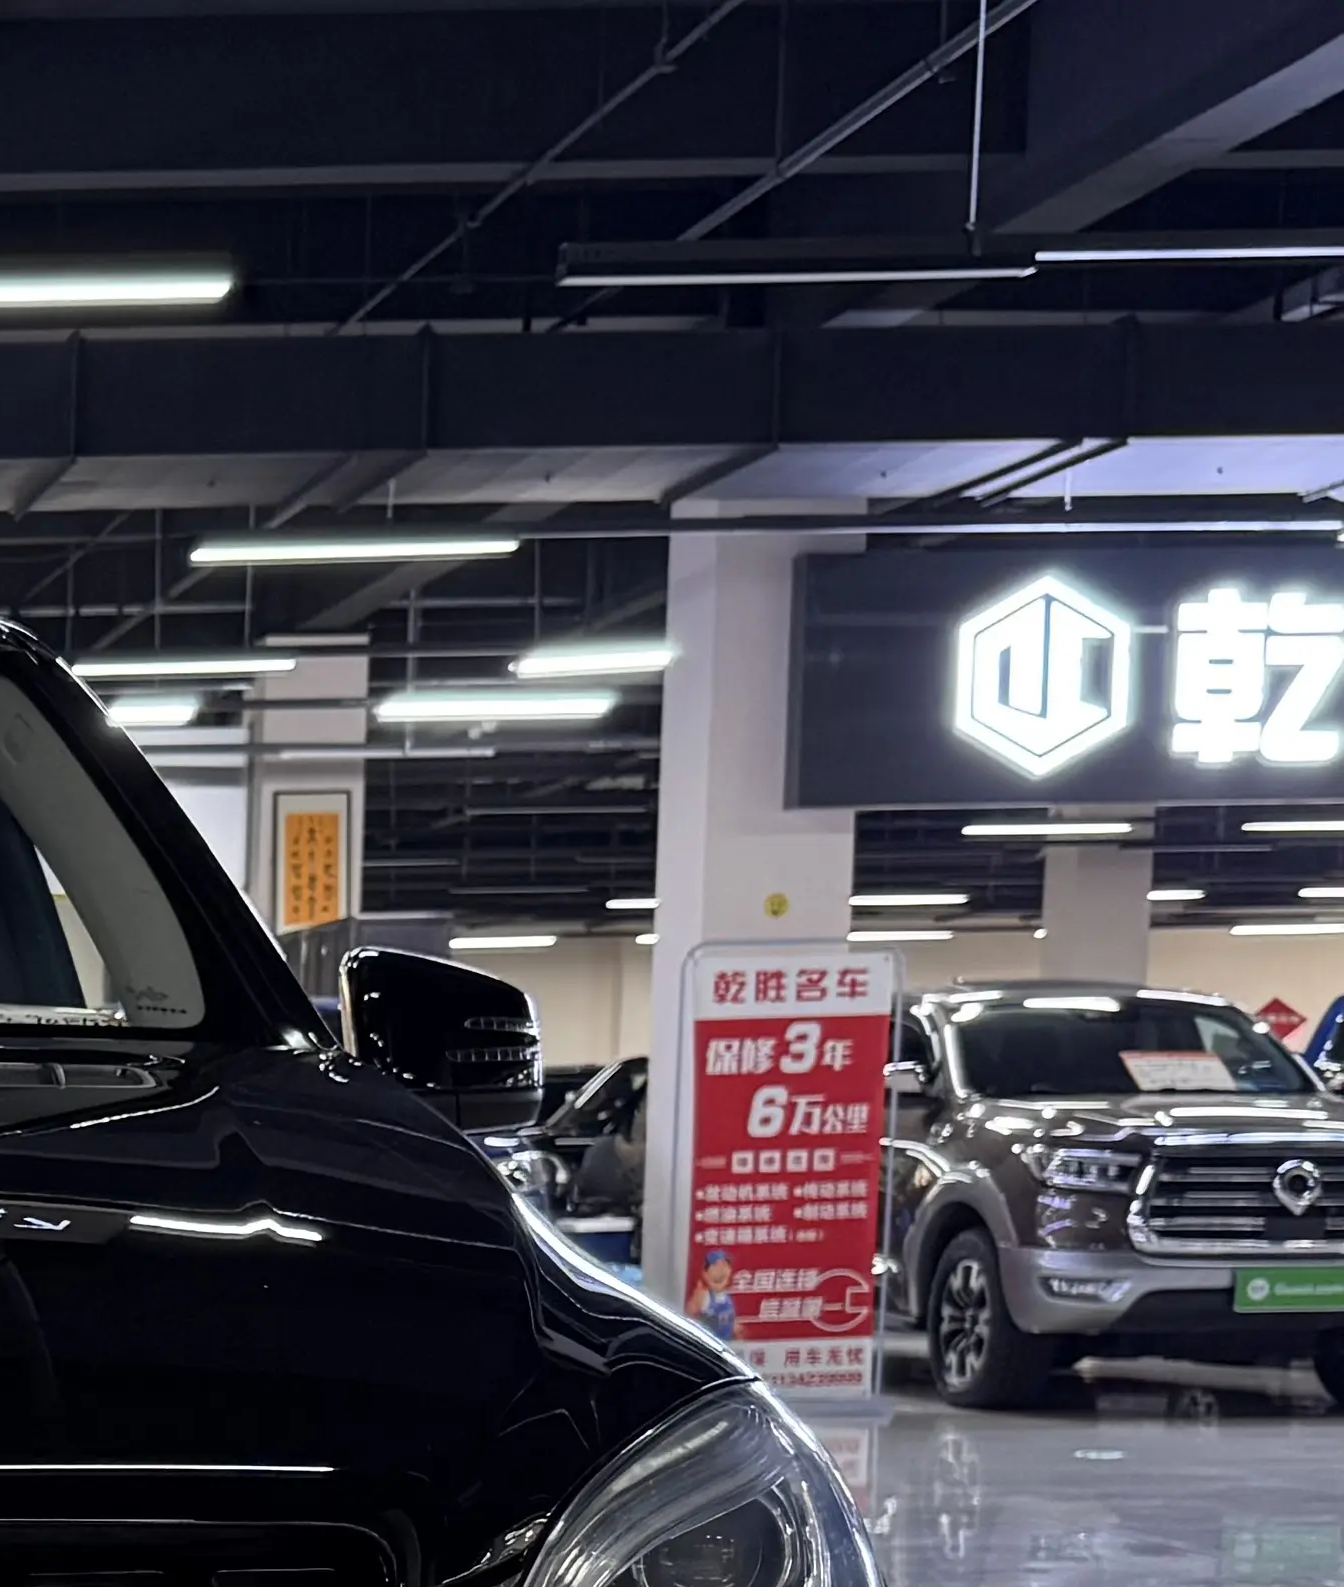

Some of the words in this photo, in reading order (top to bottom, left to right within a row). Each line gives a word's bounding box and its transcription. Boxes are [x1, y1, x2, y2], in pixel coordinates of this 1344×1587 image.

[1172, 588, 1344, 764] 乾
[713, 968, 869, 1004] 乾胜名车
[705, 1021, 854, 1076] 保修3年
[747, 1085, 869, 1138] 6万公里
